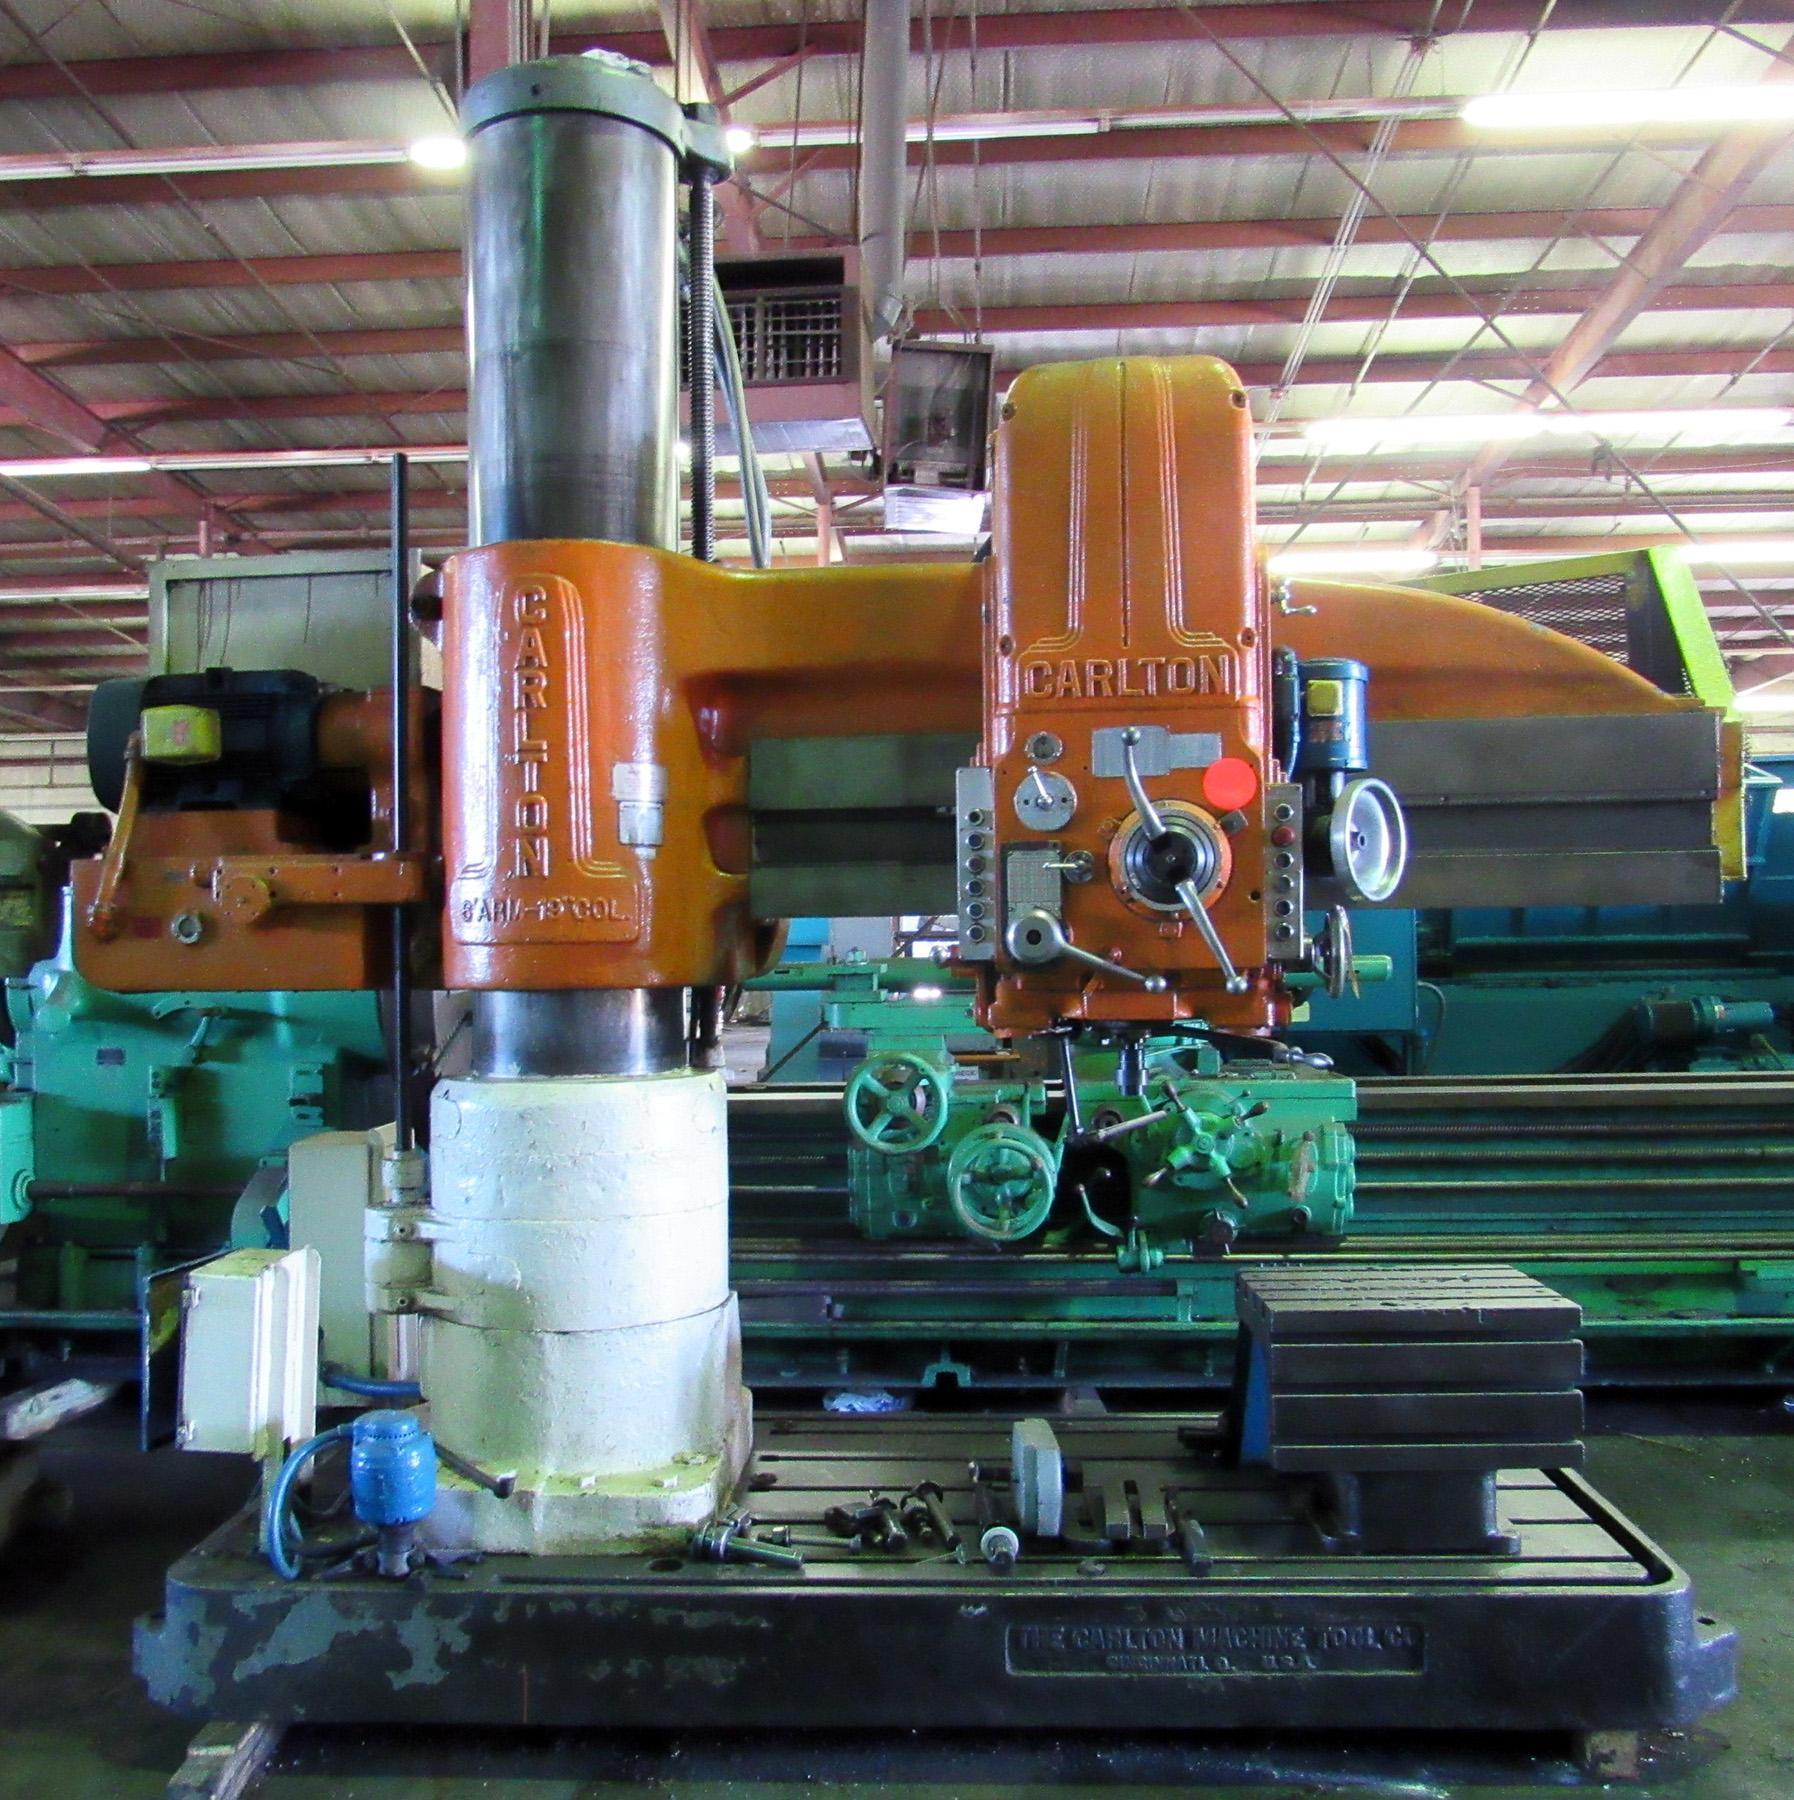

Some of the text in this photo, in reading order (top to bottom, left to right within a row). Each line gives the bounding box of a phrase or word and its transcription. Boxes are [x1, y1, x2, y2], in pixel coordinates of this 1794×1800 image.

[1024, 654, 1230, 698] CARLTON
[513, 584, 549, 879] CARLTON
[1020, 1625, 1066, 1650] THE
[1071, 1625, 1185, 1651] CARLTON
[1192, 1626, 1307, 1650] MACHINE
[1318, 1626, 1383, 1651] TOOL
